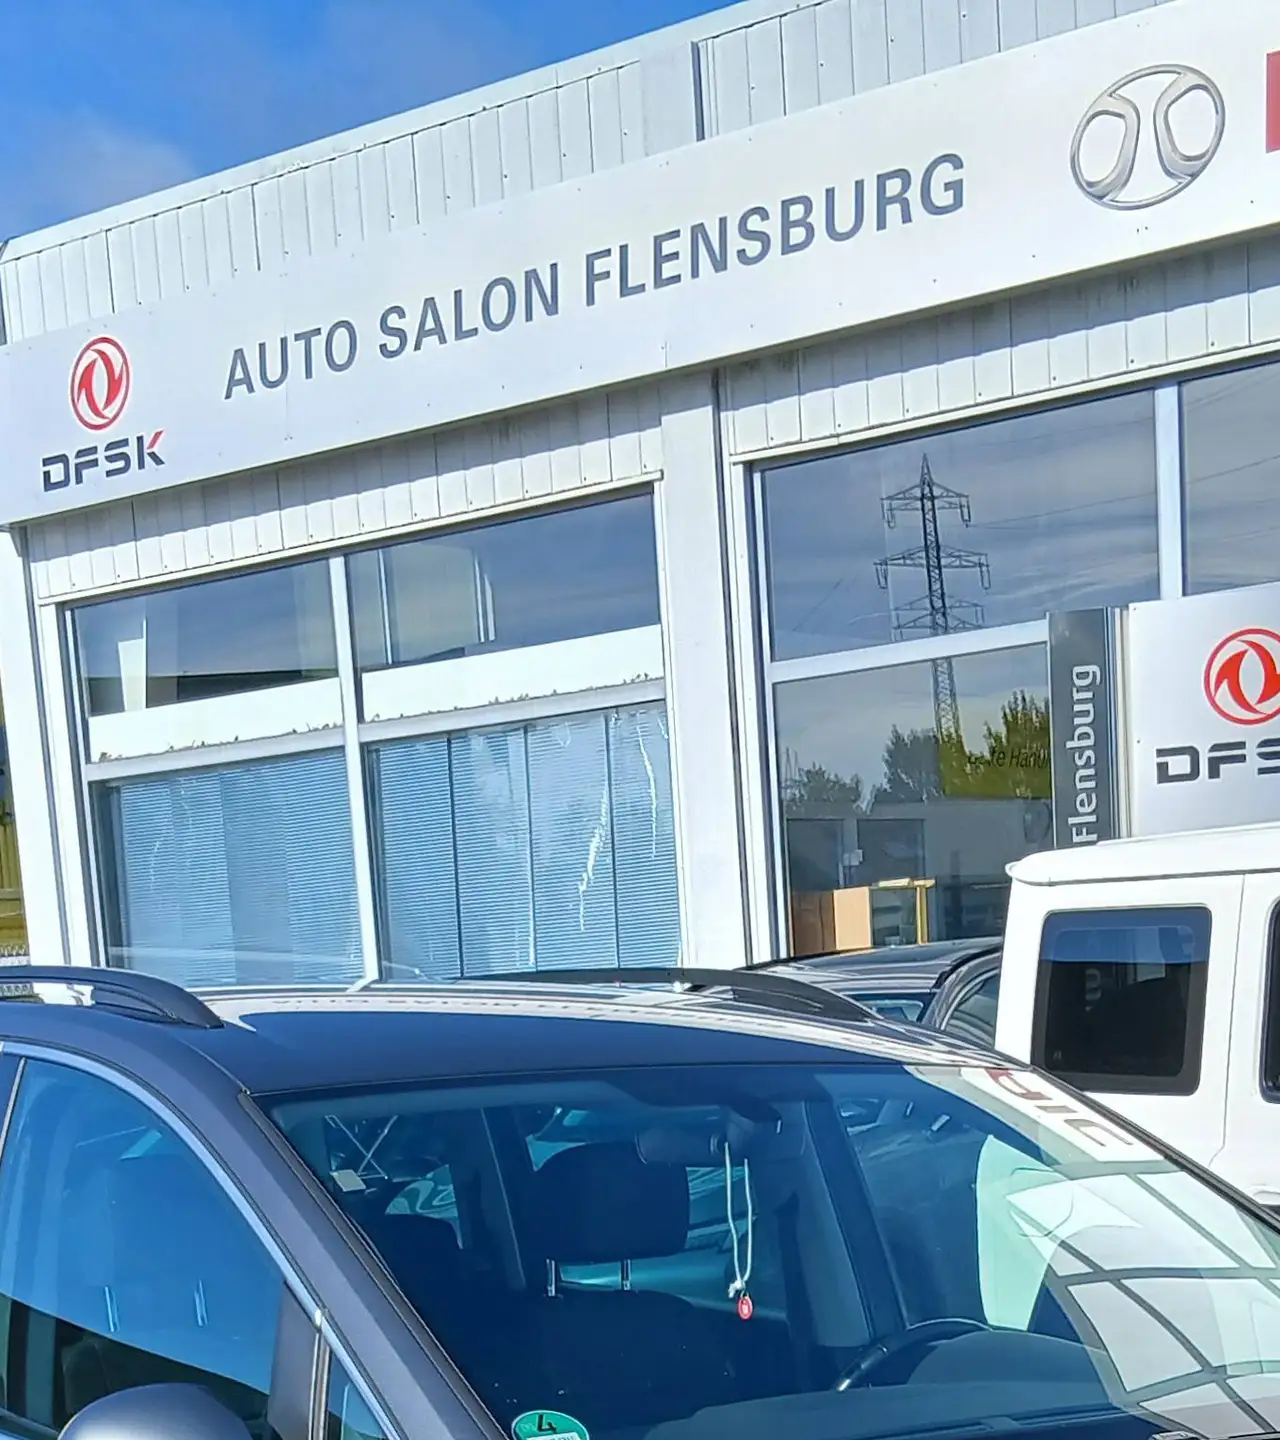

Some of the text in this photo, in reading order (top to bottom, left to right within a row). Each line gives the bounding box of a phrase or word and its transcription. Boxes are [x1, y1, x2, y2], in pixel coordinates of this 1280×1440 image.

[224, 152, 966, 400] AUTO SALON FLENSBURG
[41, 429, 166, 493] DFSK
[1066, 664, 1101, 844] Flensburg
[537, 1413, 558, 1434] 4
